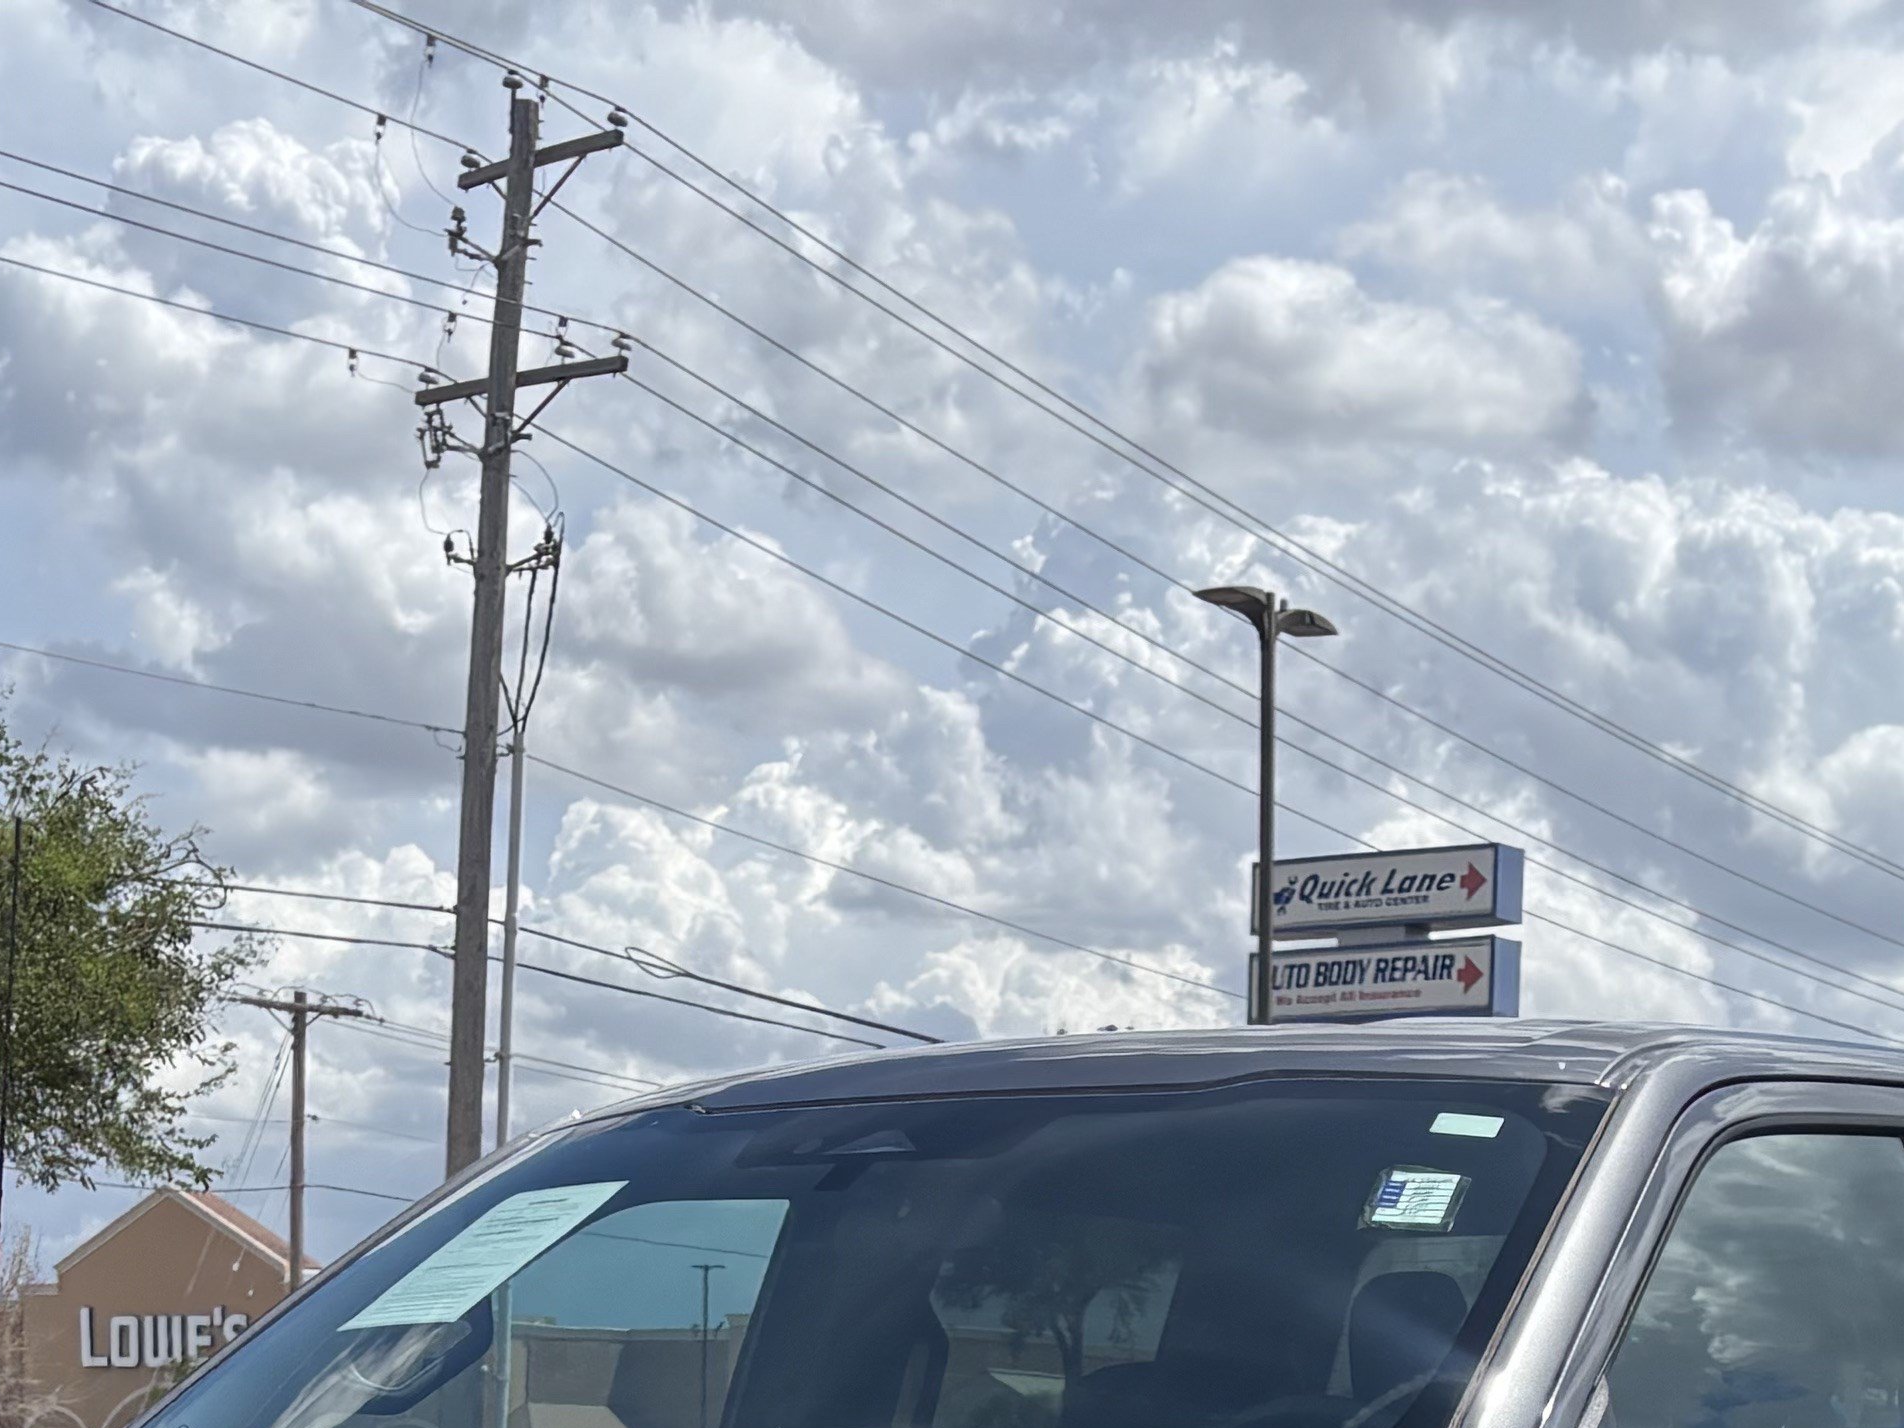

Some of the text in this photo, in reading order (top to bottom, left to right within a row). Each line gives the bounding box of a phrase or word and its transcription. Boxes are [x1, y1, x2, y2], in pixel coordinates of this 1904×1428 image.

[1299, 869, 1456, 903] Quick Lane
[1318, 902, 1340, 910] TIRE
[1354, 898, 1383, 908] AUTO
[1385, 895, 1429, 906] CENTER
[1272, 954, 1456, 990] UTO BODY REPAIR
[80, 1306, 248, 1368] LOWE'S
